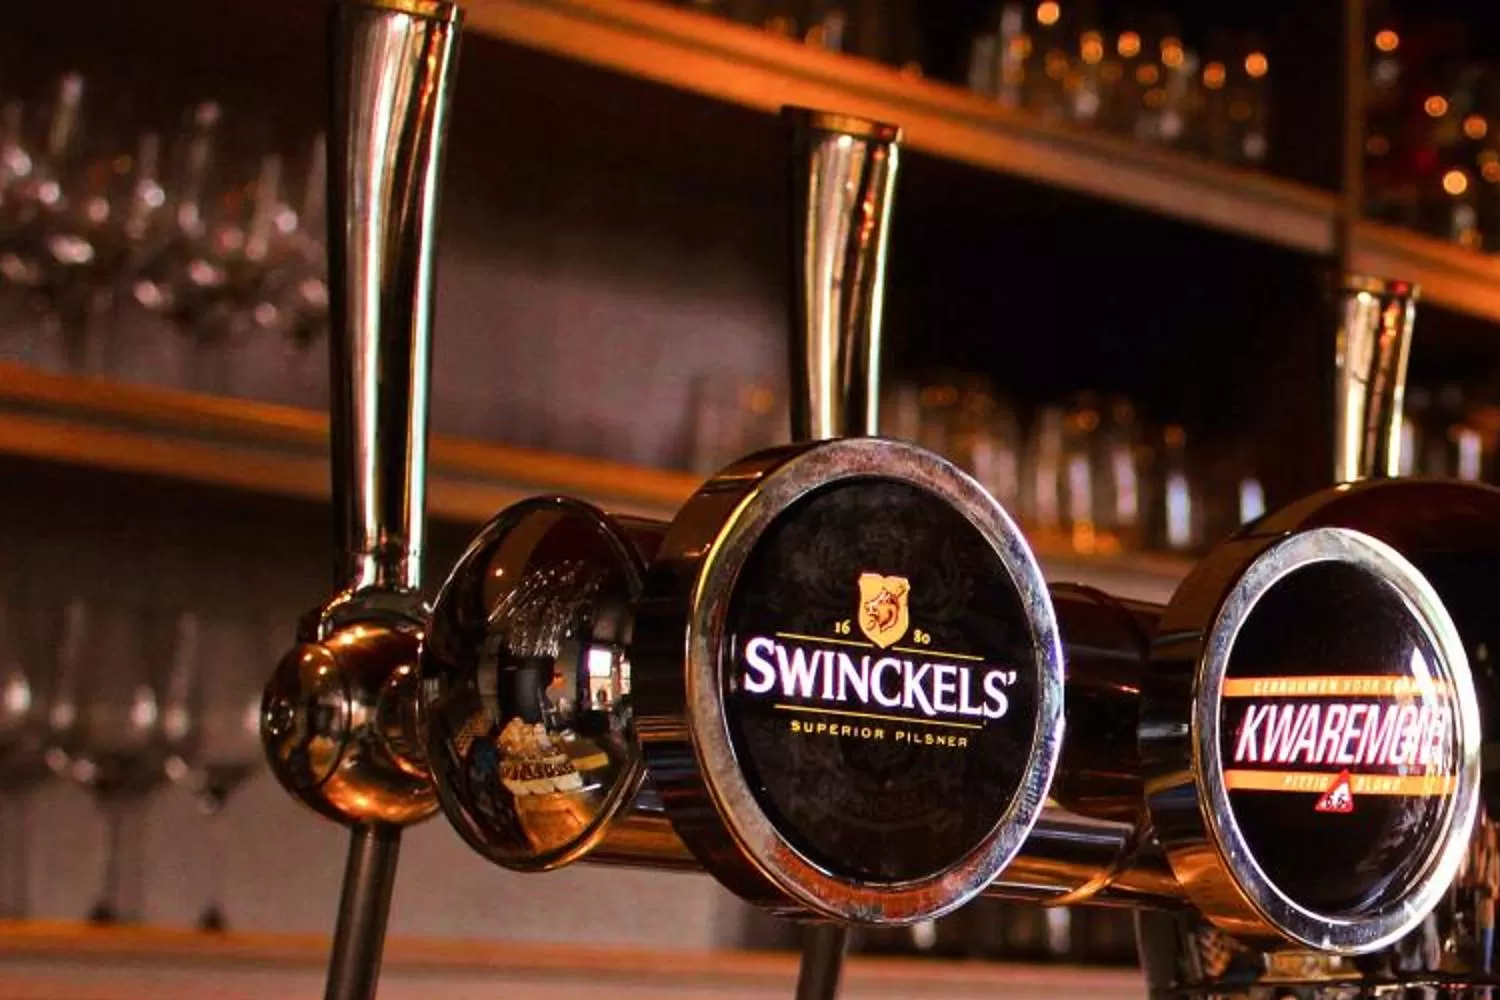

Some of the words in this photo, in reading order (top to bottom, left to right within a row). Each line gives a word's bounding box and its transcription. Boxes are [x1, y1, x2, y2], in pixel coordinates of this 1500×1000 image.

[834, 619, 851, 634] 16
[913, 628, 931, 644] 80
[744, 637, 1016, 719] SWINCKELS'
[789, 719, 885, 740] SUPERIOR
[895, 730, 968, 748] PILSNER
